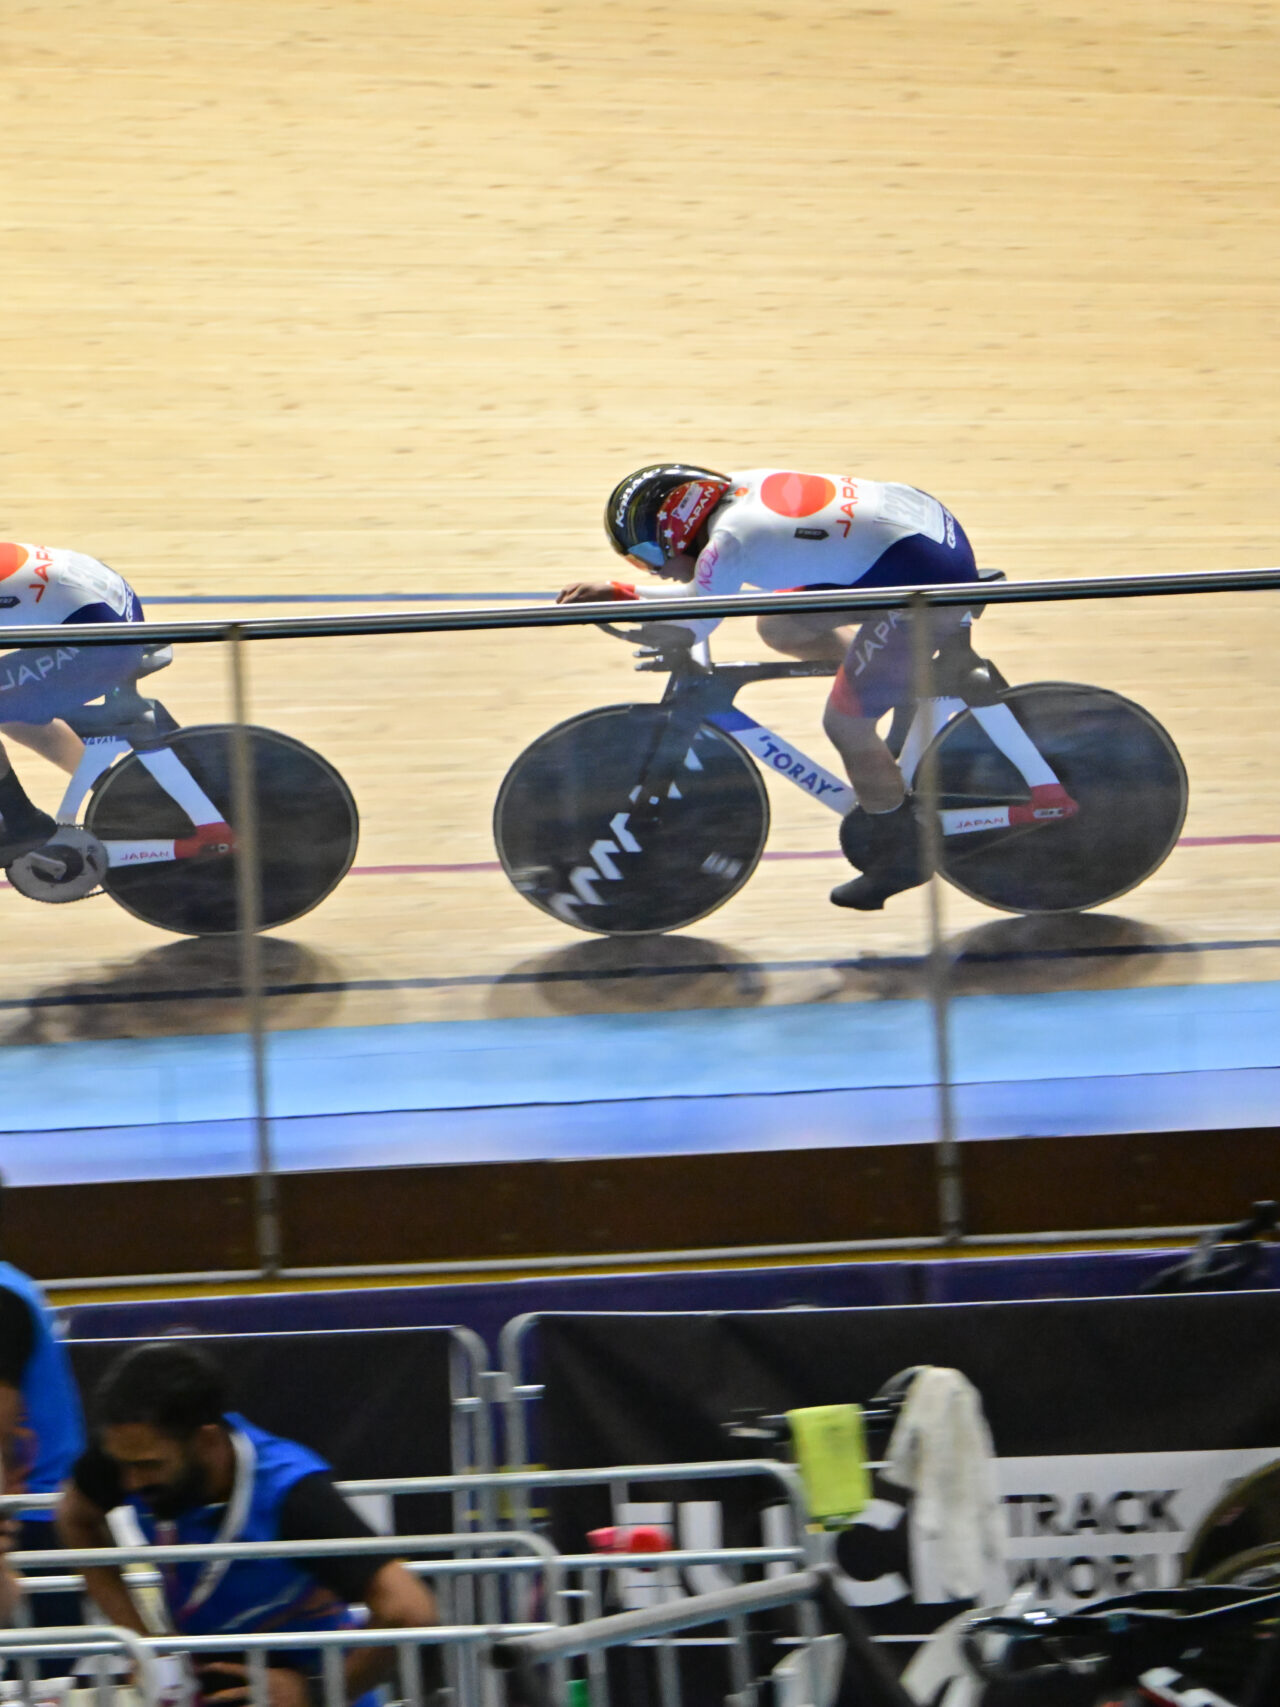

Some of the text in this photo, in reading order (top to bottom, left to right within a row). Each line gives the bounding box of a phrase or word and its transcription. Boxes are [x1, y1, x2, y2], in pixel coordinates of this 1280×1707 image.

[683, 485, 716, 536] JAPAN
[956, 817, 1004, 829] JAPAN
[120, 850, 169, 861] JAPAN
[1003, 1489, 1183, 1538] TRACK
